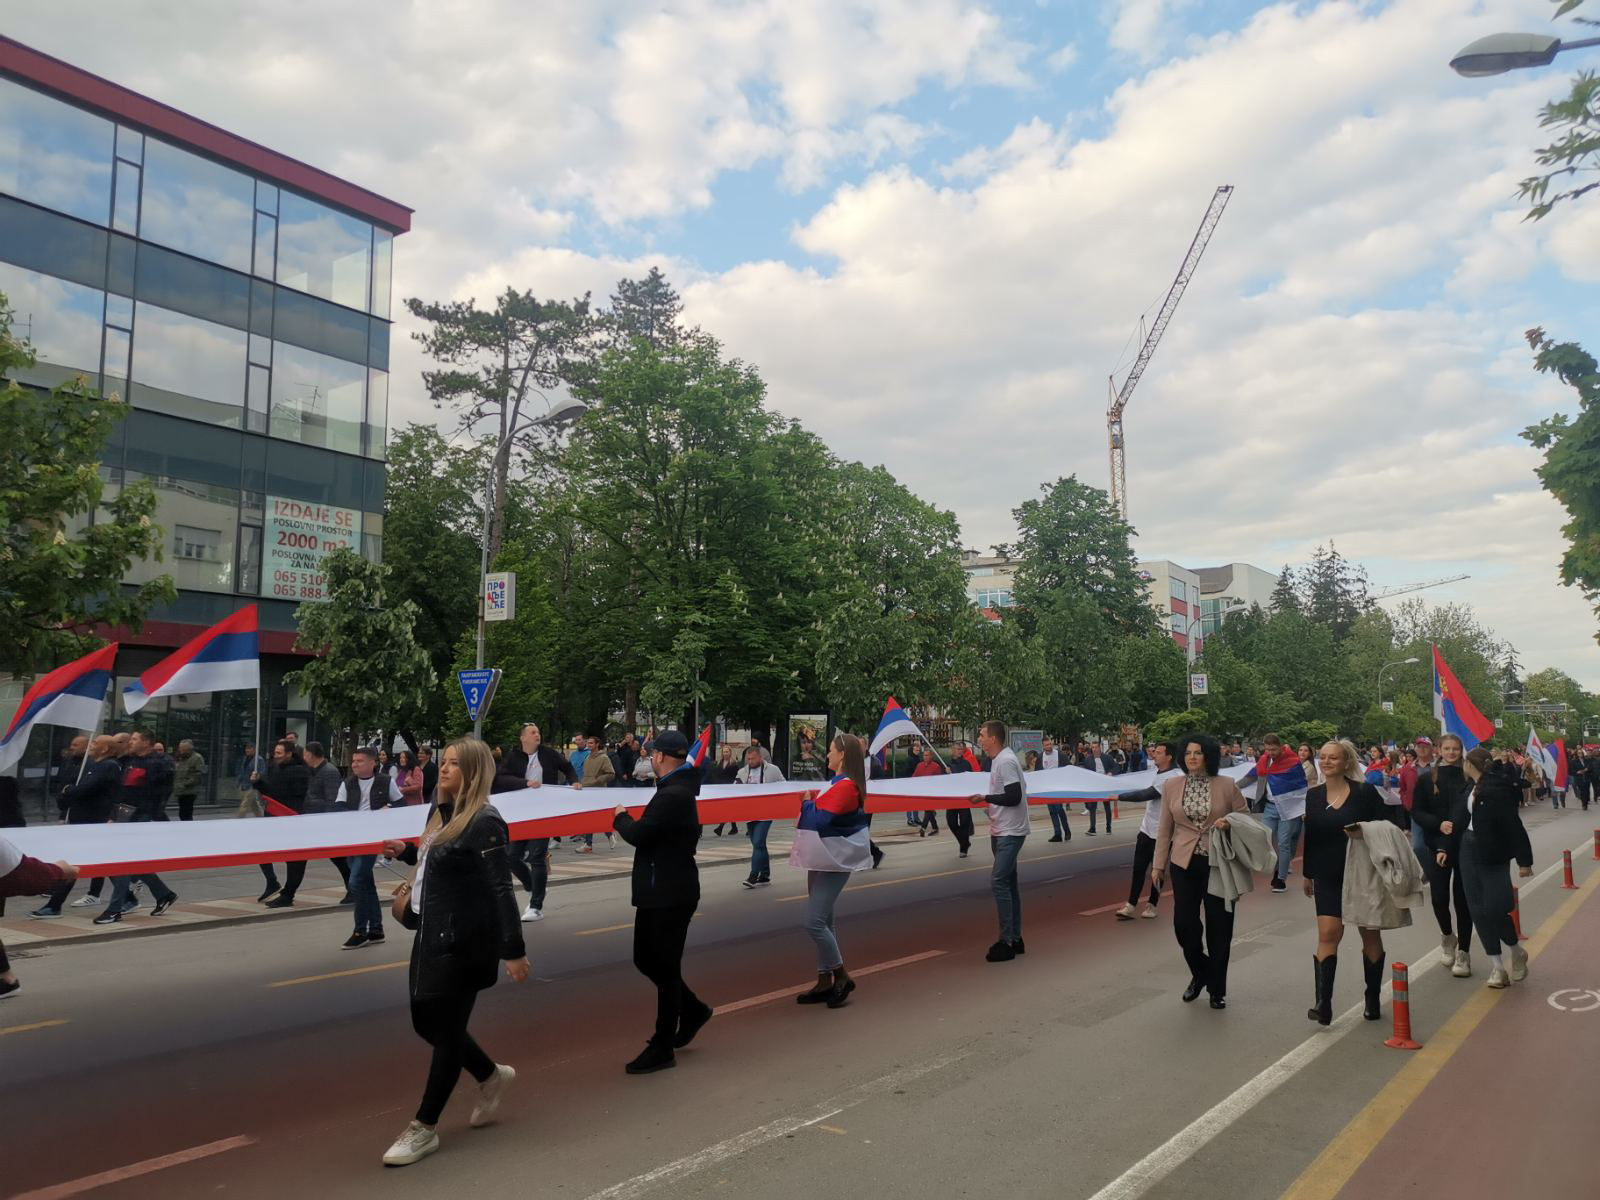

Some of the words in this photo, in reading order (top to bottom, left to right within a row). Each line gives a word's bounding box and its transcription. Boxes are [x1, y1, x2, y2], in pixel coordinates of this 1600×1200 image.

[274, 500, 329, 523] IZDAJE
[335, 511, 353, 527] SE
[273, 518, 315, 531] POSLOVNI
[317, 525, 353, 537] PROSTOR
[277, 531, 318, 550] 2000
[272, 549, 316, 562] POSLOVNA
[290, 560, 302, 568] ZA
[273, 570, 297, 583] 065
[273, 583, 296, 596] 065
[470, 686, 478, 703] 3
